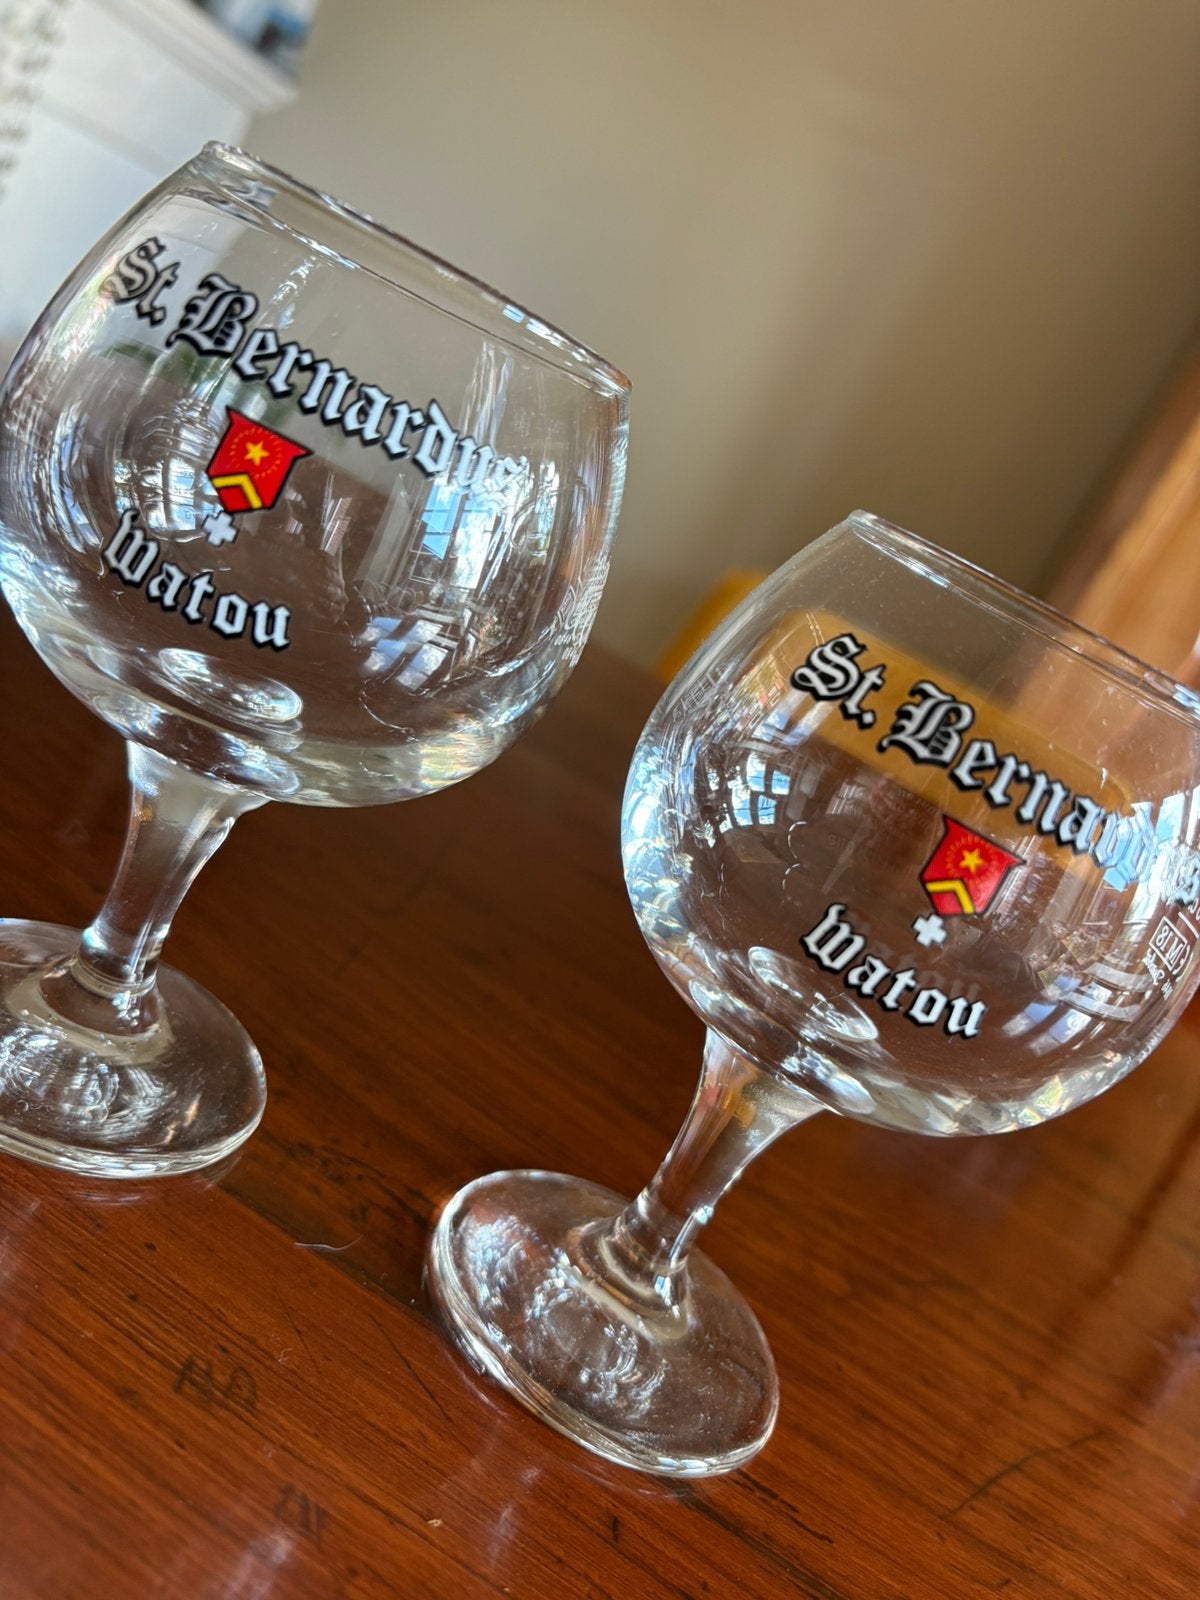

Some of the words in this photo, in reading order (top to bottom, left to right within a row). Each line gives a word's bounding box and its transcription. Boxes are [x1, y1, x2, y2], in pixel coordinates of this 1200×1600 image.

[98, 236, 181, 327] St.
[103, 508, 291, 652] Watou
[790, 633, 886, 730] St.
[799, 903, 987, 1039] Watou
